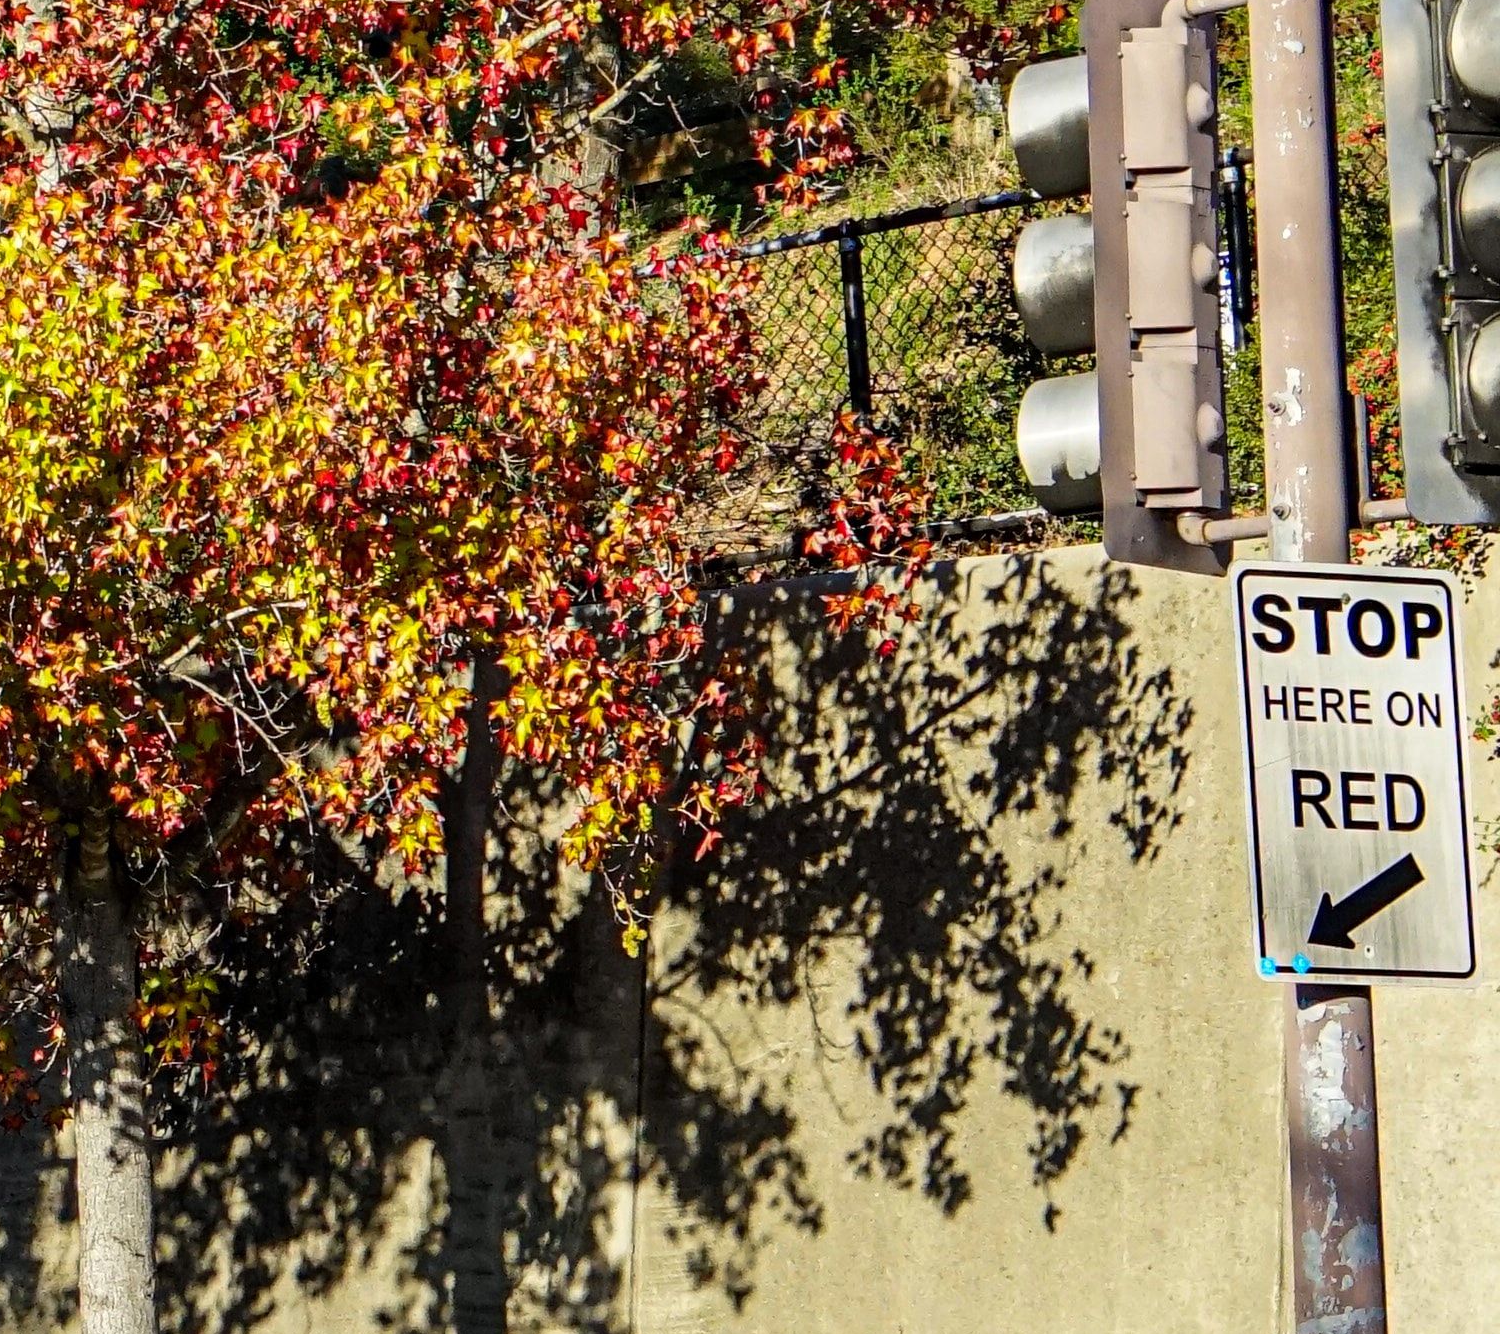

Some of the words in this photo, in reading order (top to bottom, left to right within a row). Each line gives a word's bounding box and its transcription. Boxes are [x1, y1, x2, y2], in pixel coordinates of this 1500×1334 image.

[1251, 593, 1444, 660] STOP
[1263, 685, 1373, 725] HERE
[1386, 690, 1443, 729] ON
[1291, 769, 1427, 832] RED
